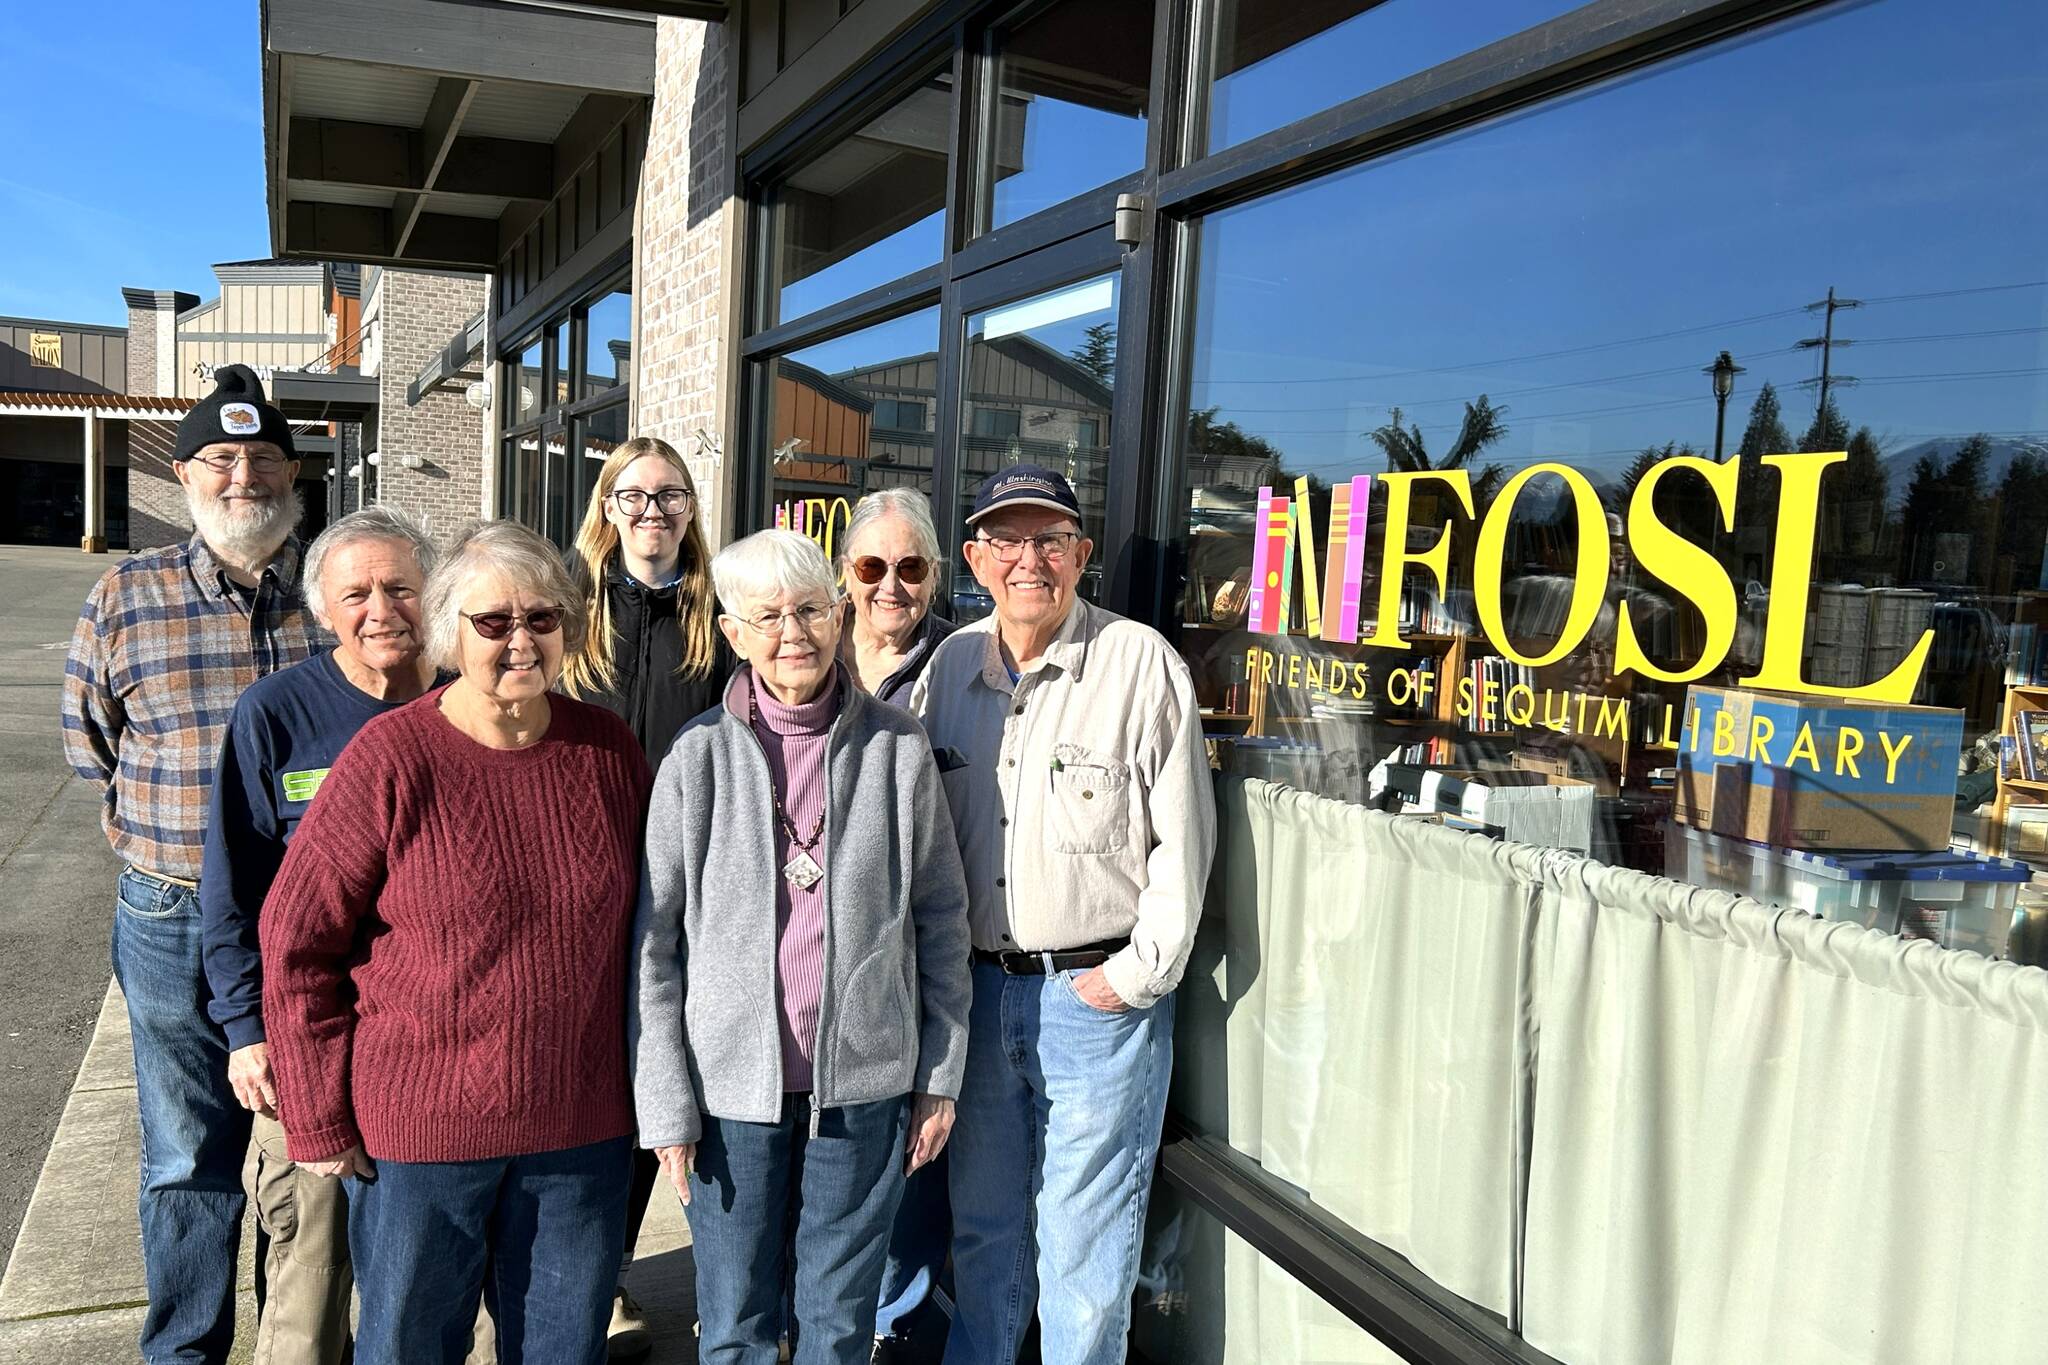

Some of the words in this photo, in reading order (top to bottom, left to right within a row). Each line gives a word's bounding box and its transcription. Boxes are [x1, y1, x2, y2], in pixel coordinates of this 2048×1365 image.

[1362, 451, 1935, 704] FOSL
[1245, 649, 1368, 701] FRIENDS
[1387, 667, 1435, 709] OF
[1456, 676, 1630, 742] SEQUIM
[1662, 703, 1914, 784] LIBRARY
